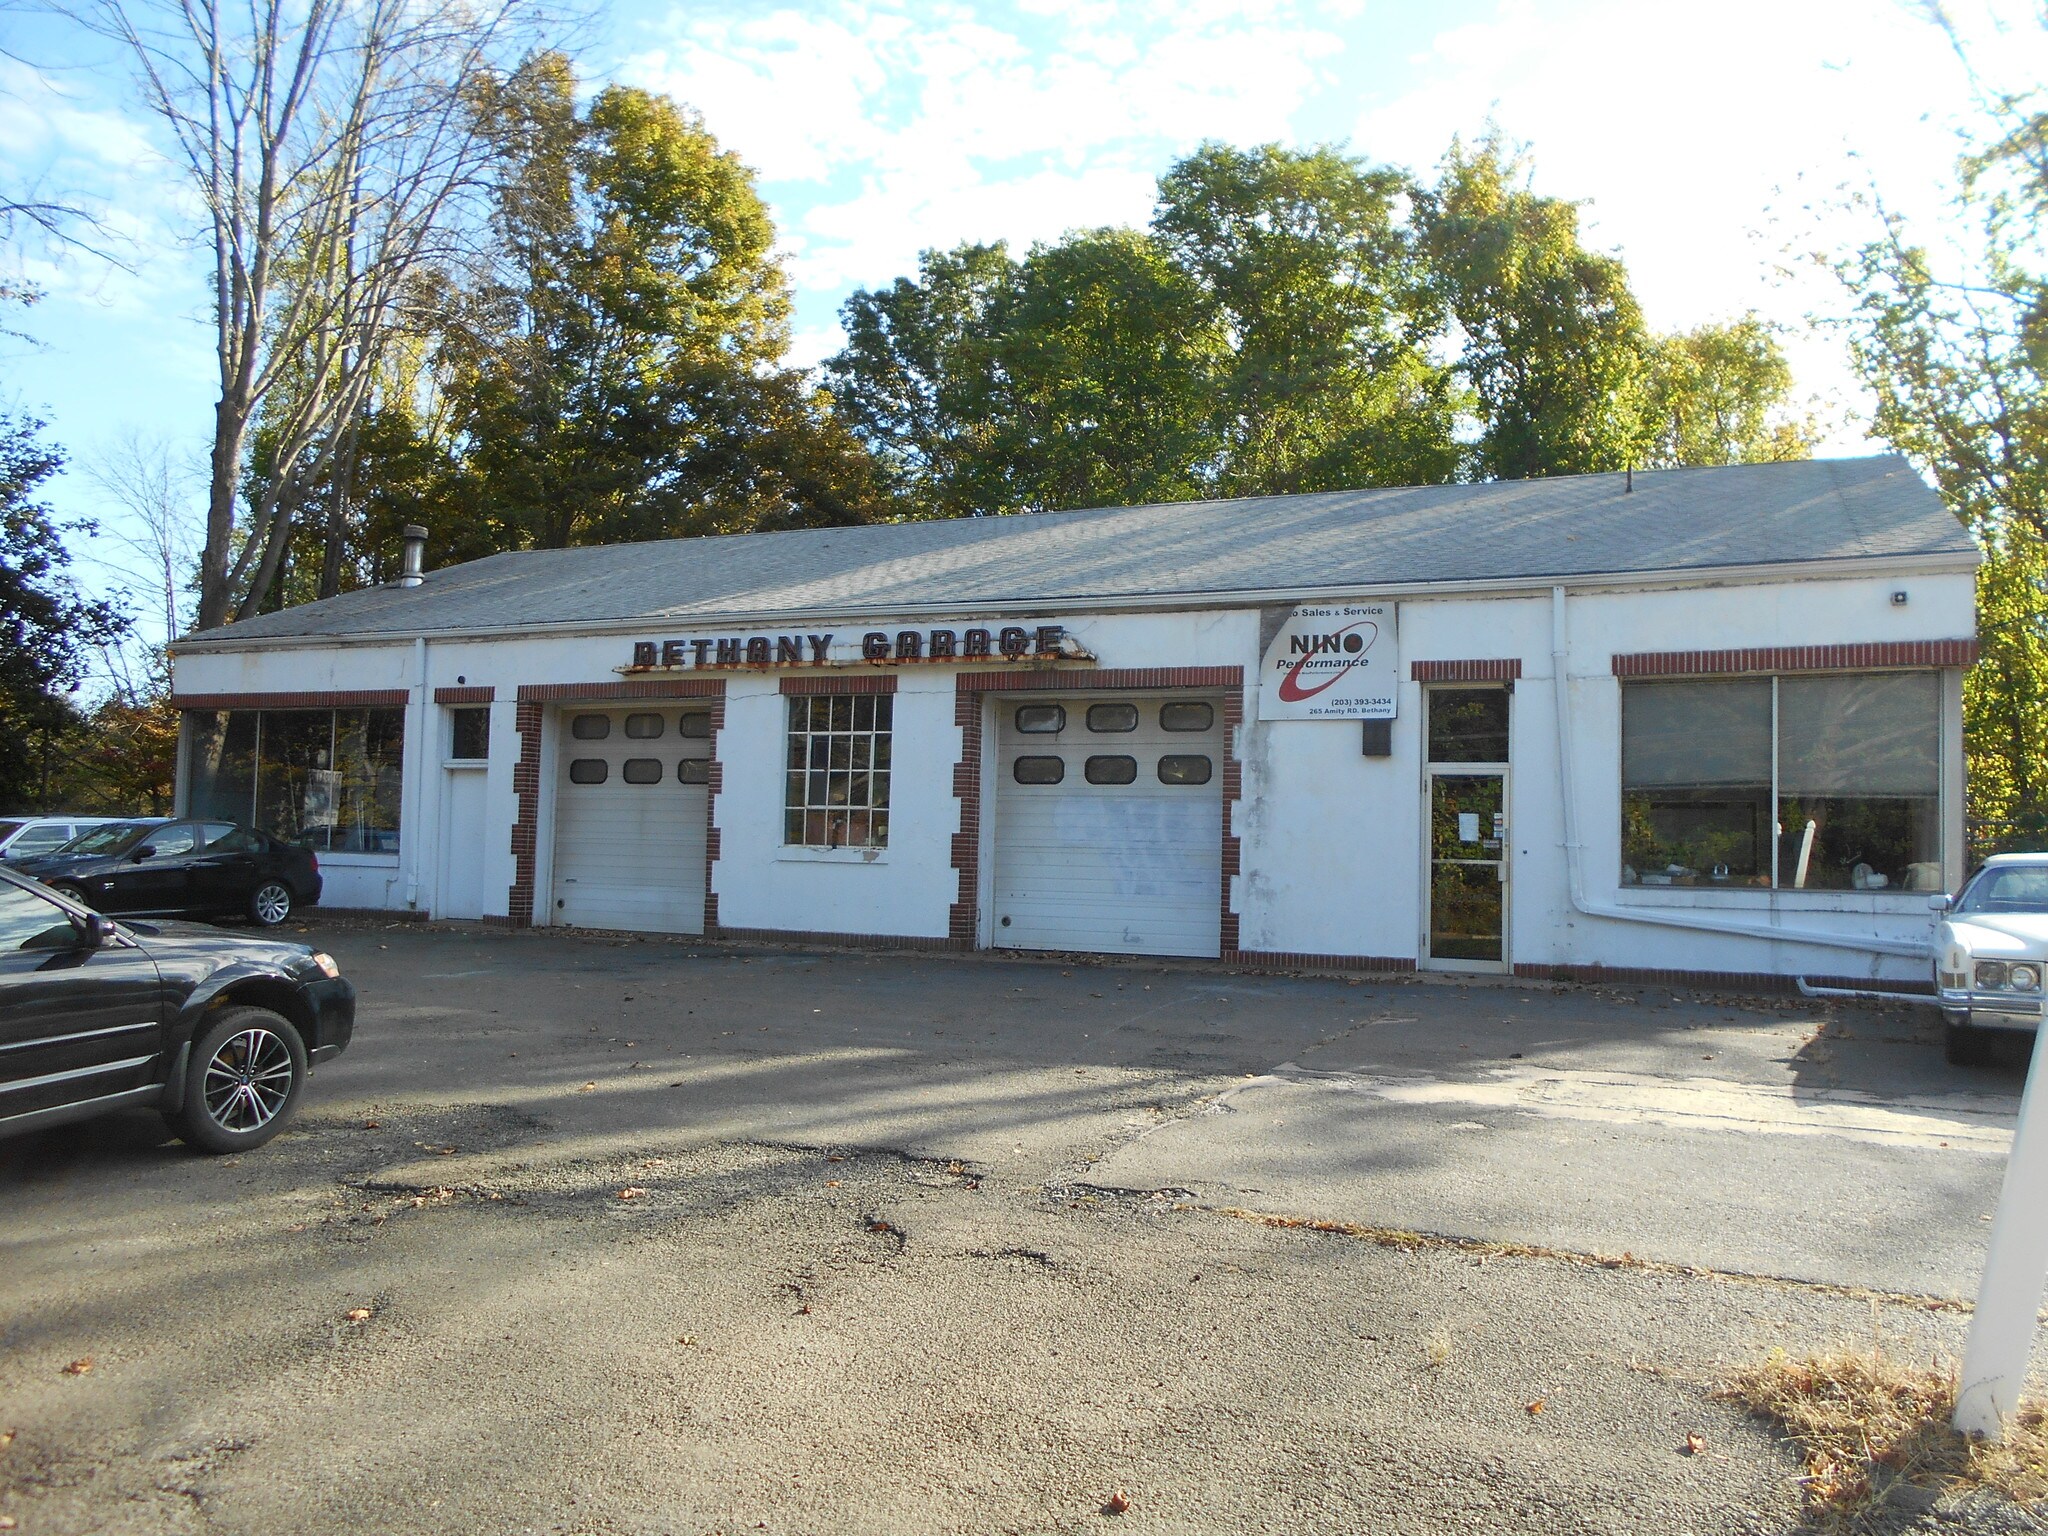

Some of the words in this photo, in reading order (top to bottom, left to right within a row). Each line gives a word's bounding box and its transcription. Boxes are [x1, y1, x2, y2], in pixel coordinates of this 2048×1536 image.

[1302, 608, 1331, 617] Sales
[1343, 607, 1383, 616] Service
[634, 634, 834, 666] BETHANY
[862, 626, 1065, 659] GARAGE
[1290, 633, 1363, 654] NINO
[1331, 698, 1352, 707] (203)
[1354, 698, 1391, 706] 393-3434
